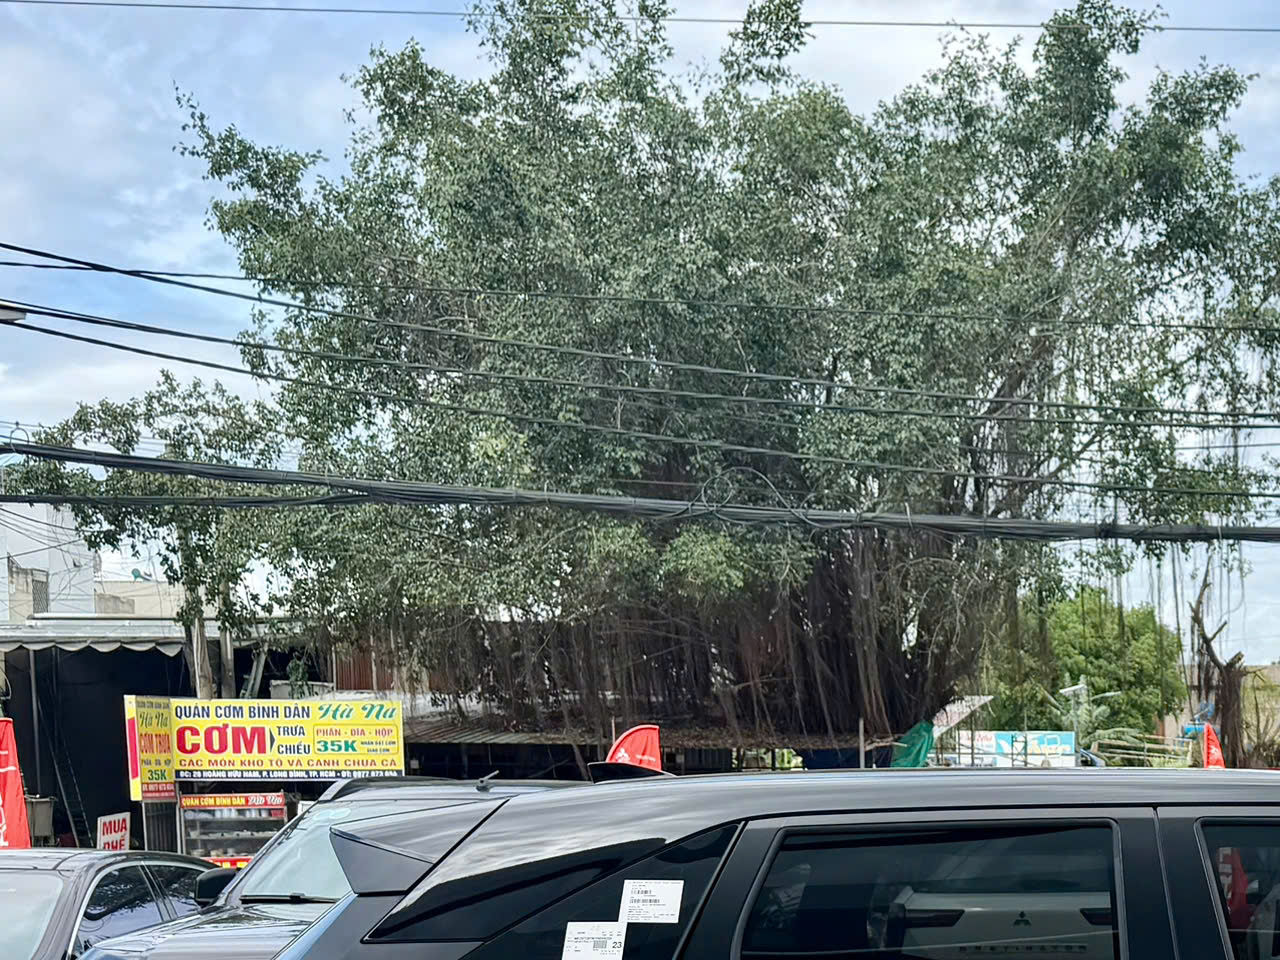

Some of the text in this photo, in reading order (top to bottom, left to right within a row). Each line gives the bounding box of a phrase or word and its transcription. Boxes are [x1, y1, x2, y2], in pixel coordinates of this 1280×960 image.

[175, 701, 397, 721] QUÁN CƠM BÌNH DÂN Hà Na
[276, 724, 306, 737] TRƯA
[176, 723, 267, 754] CƠM
[316, 740, 358, 752] 35K
[178, 758, 204, 768] CÁC
[208, 757, 236, 768] MÓN
[240, 758, 264, 768] KHO
[307, 758, 340, 768] CANH
[344, 758, 377, 768] CHUA
[147, 770, 167, 781] 35K
[102, 817, 127, 837] MUA
[612, 941, 623, 949] 23
